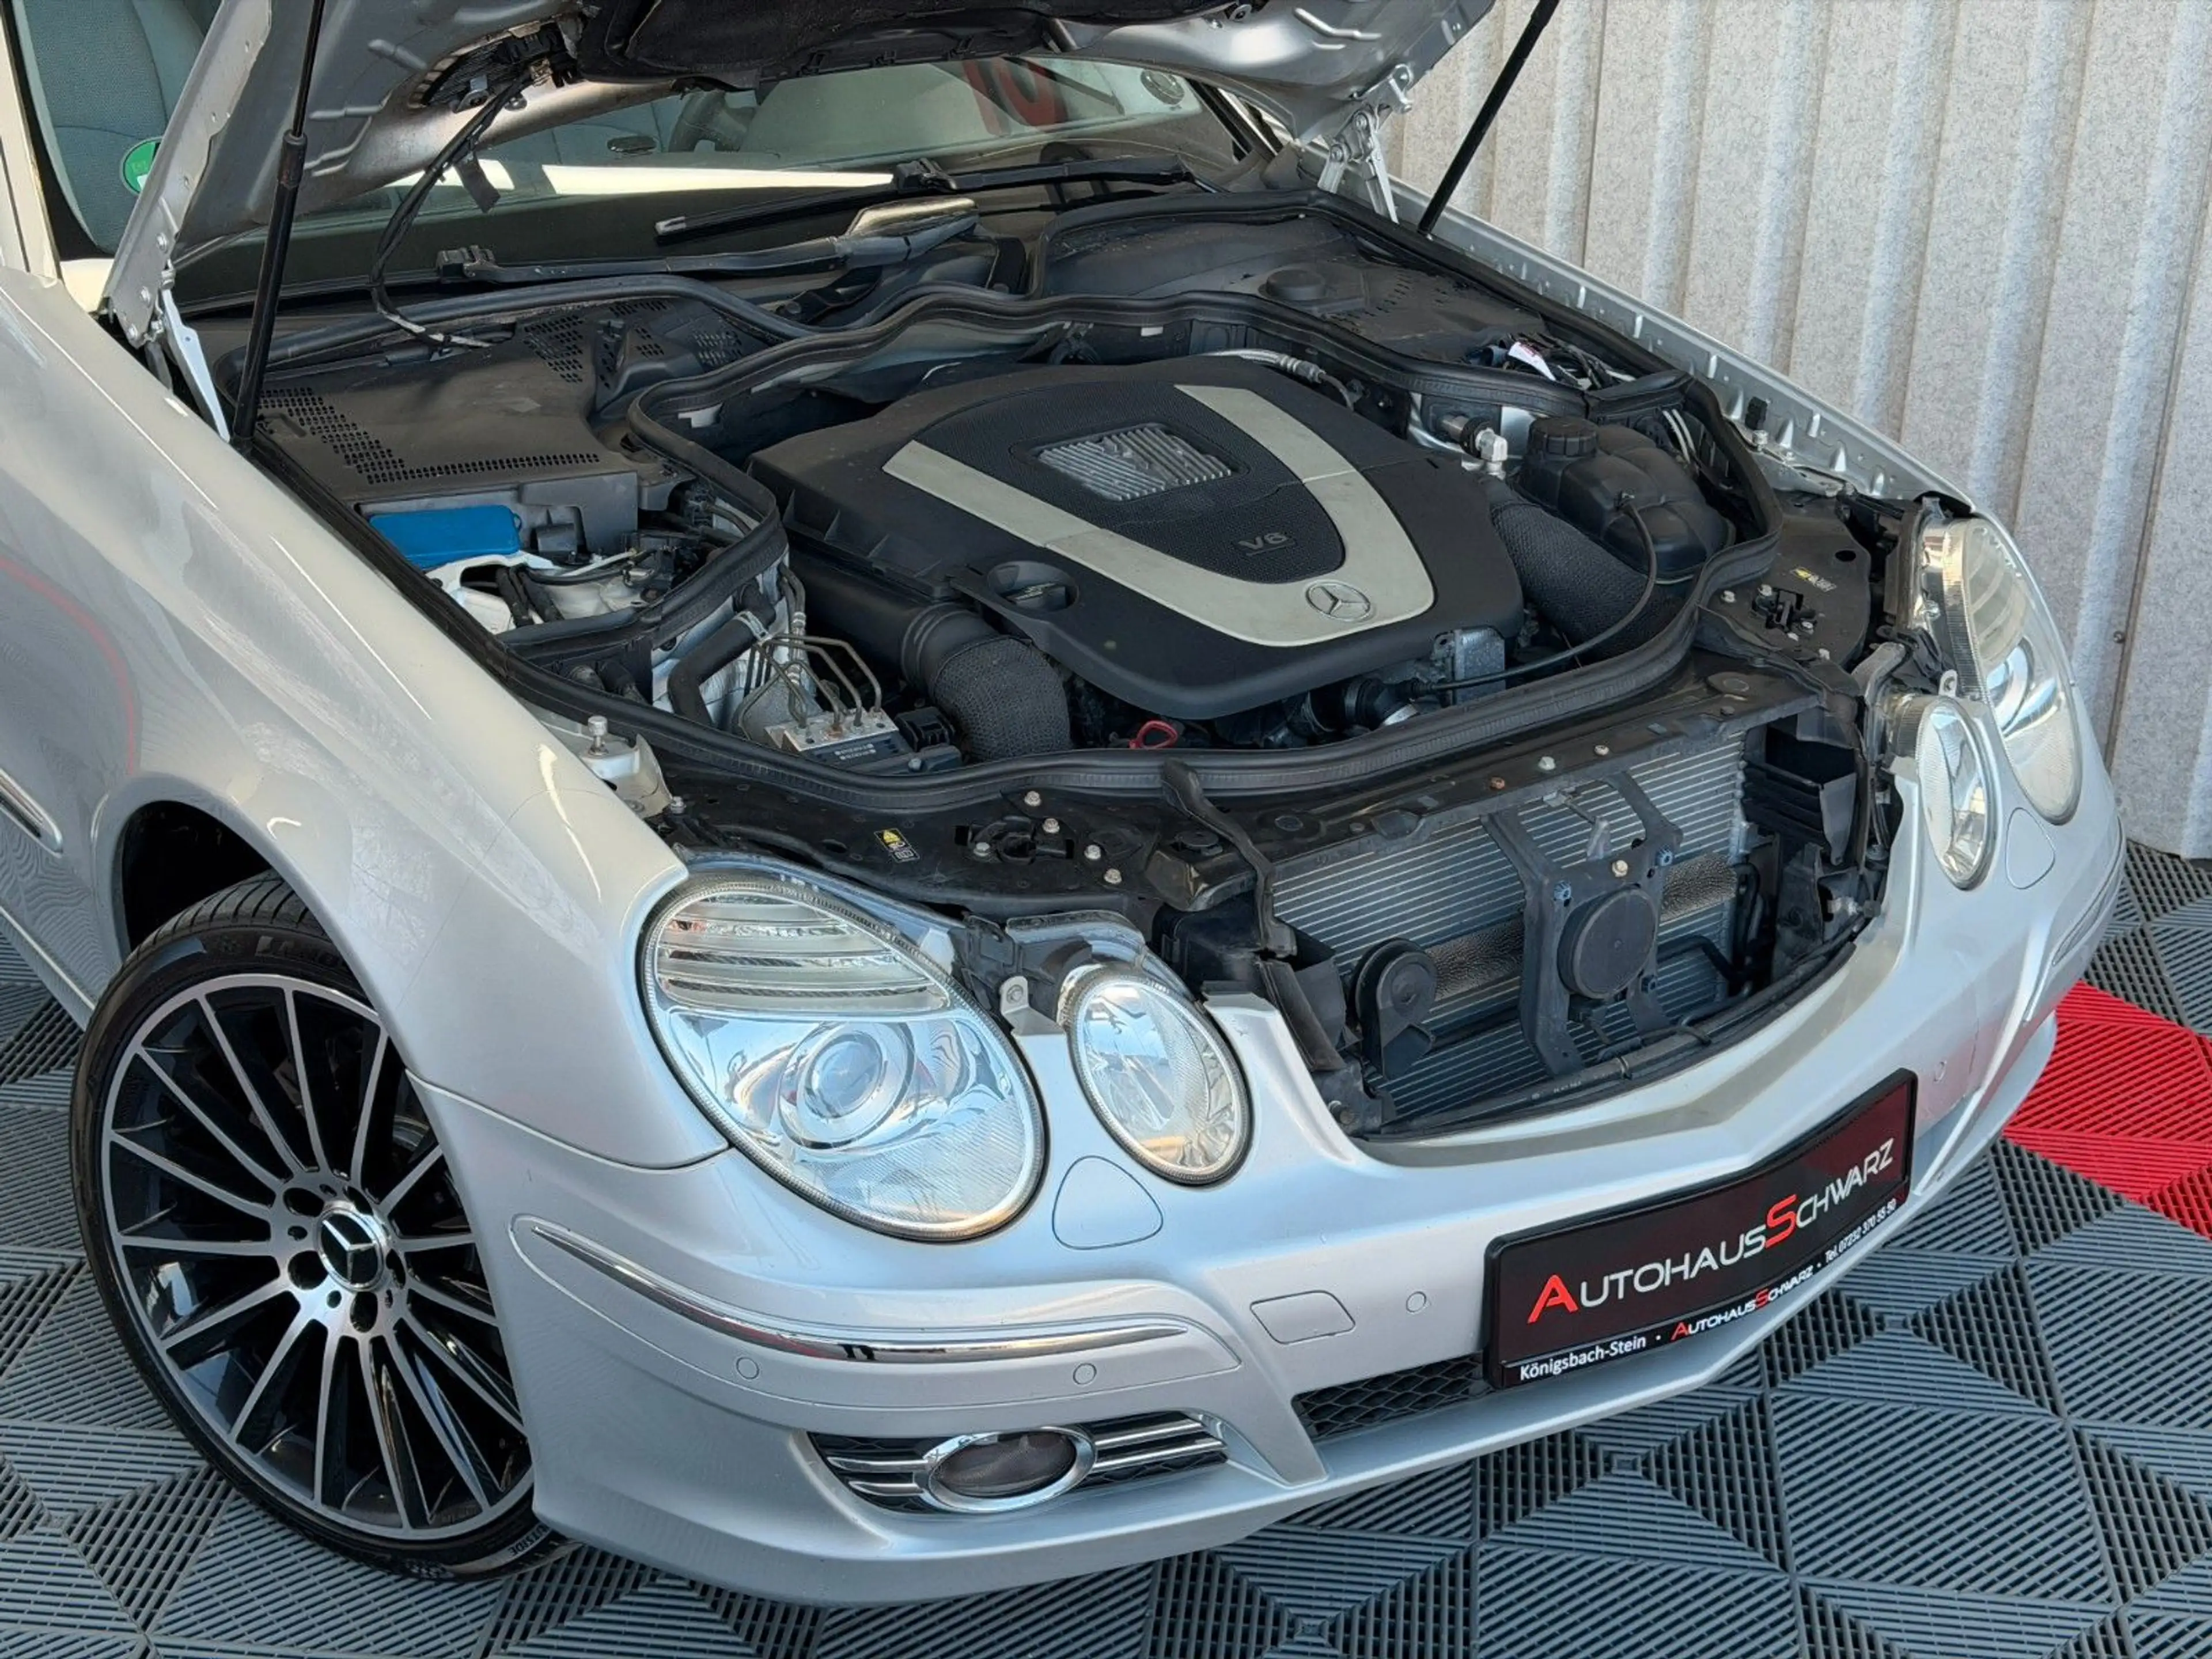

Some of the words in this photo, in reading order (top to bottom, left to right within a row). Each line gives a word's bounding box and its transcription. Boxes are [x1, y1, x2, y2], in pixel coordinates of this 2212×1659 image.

[1237, 532, 1289, 551] V6
[1520, 1335, 1646, 1381] Königsbach-Stein
[1838, 1226, 1862, 1253] 07232
[1862, 1214, 1877, 1234] 370
